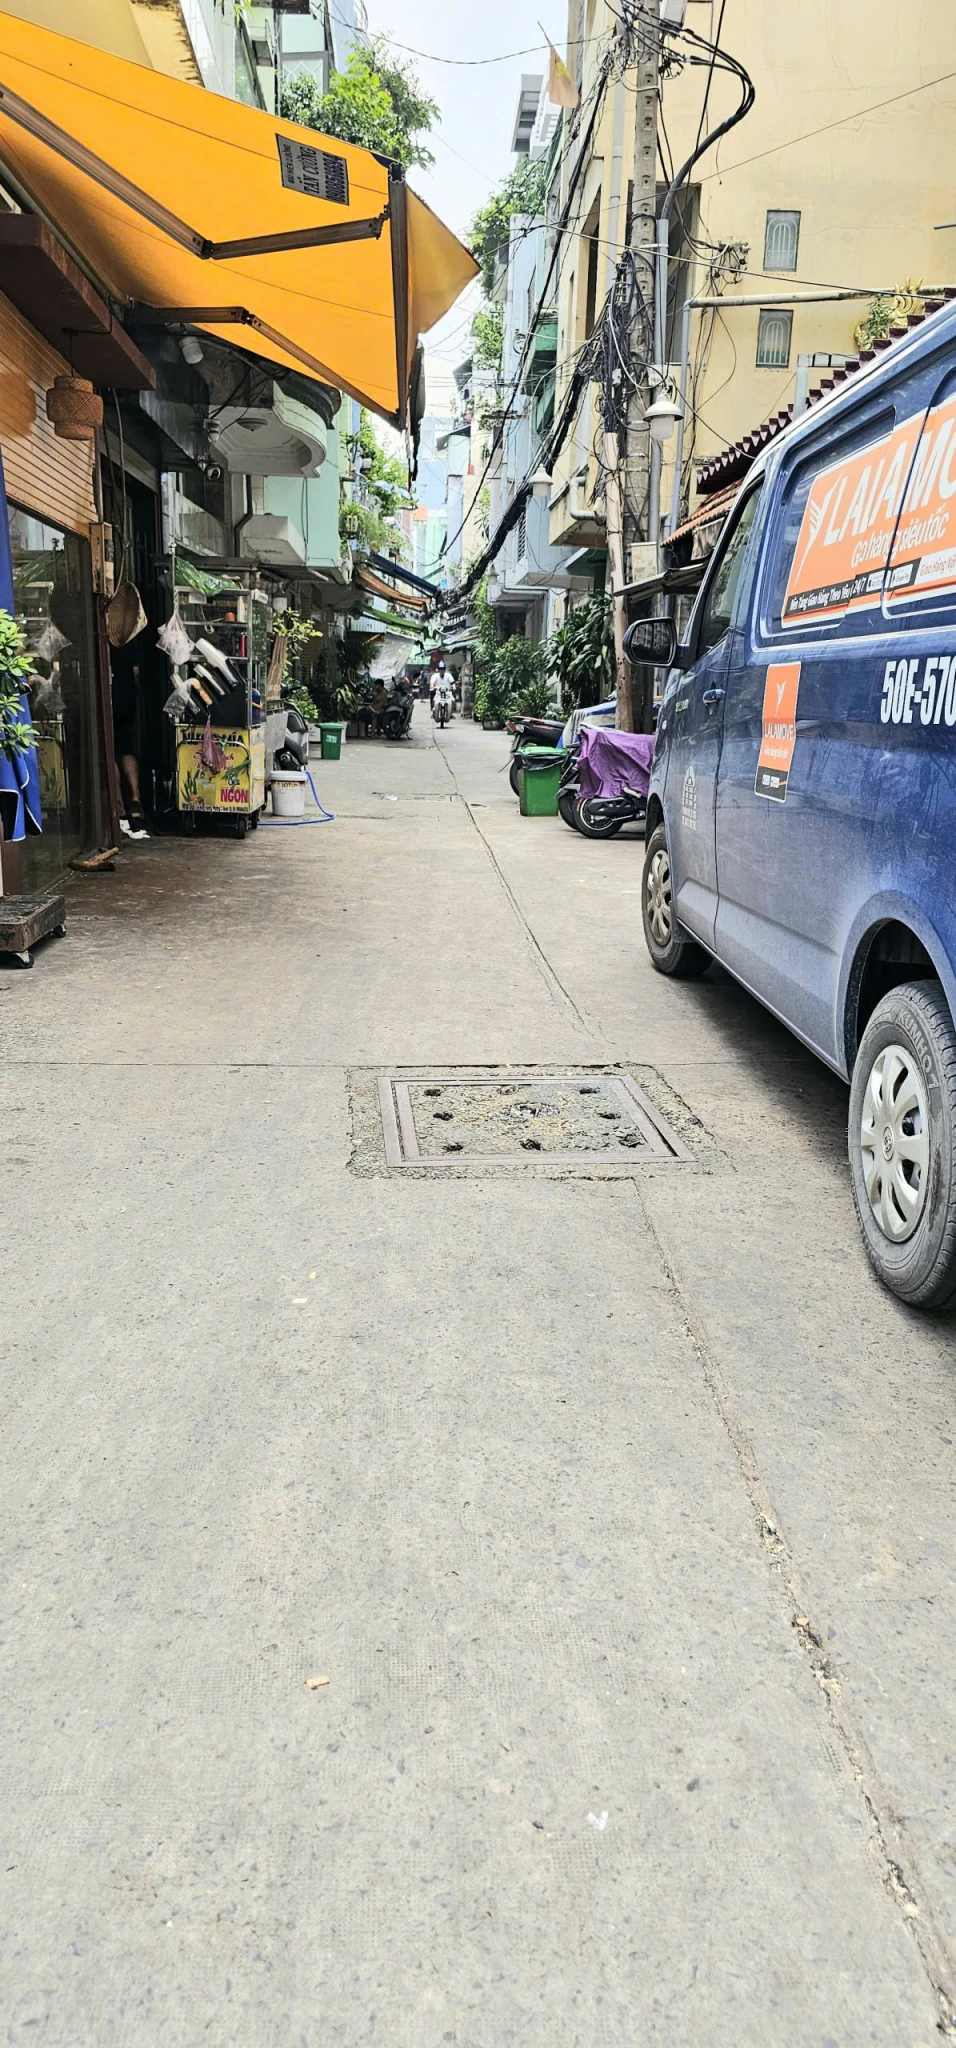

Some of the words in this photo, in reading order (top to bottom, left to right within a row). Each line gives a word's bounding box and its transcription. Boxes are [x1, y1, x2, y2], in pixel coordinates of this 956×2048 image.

[296, 146, 319, 175] CƯỜNG
[297, 174, 320, 194] TẤN
[765, 722, 793, 740] LALAMOVE
[220, 788, 249, 804] NGON
